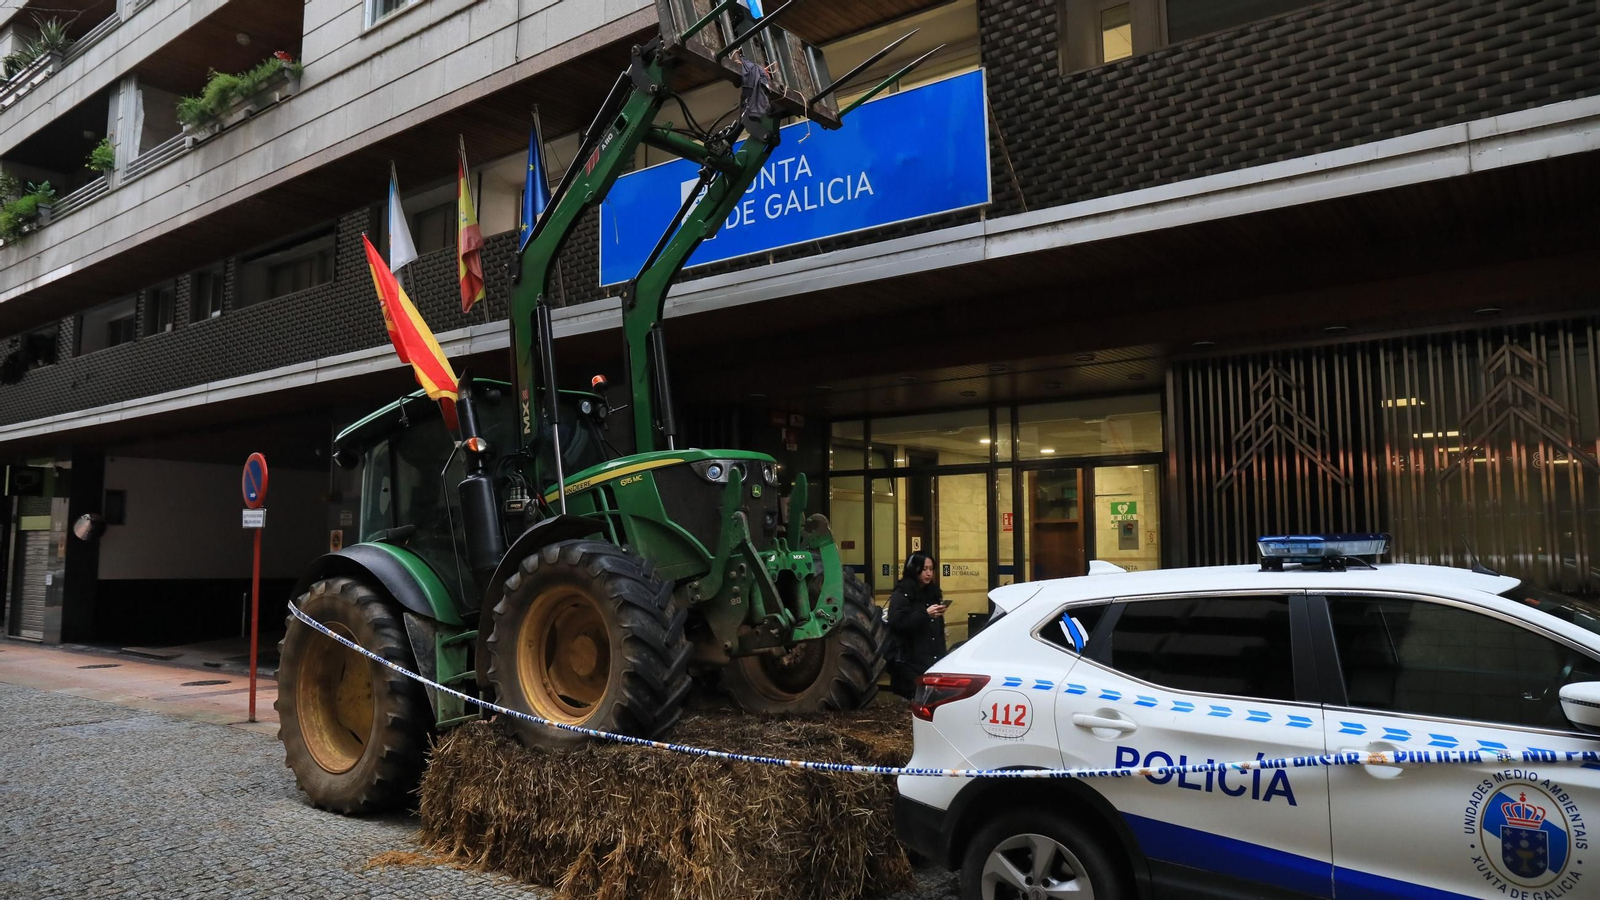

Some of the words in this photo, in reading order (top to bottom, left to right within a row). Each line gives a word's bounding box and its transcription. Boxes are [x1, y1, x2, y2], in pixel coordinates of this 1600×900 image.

[744, 154, 813, 194] UNTA
[725, 199, 756, 230] DE
[764, 171, 875, 220] GALICIA
[522, 401, 531, 434] MX
[989, 702, 1027, 727] 112
[1115, 745, 1298, 807] POLICÍA
[1522, 750, 1558, 764] NO
[1464, 779, 1494, 835] UNIDADES
[1492, 769, 1539, 784] MEDIO
[1540, 779, 1588, 850] AMBIENTAIS
[1471, 855, 1508, 894] XUNTA
[1510, 888, 1530, 900] DE
[1532, 870, 1583, 900] GALICIA
